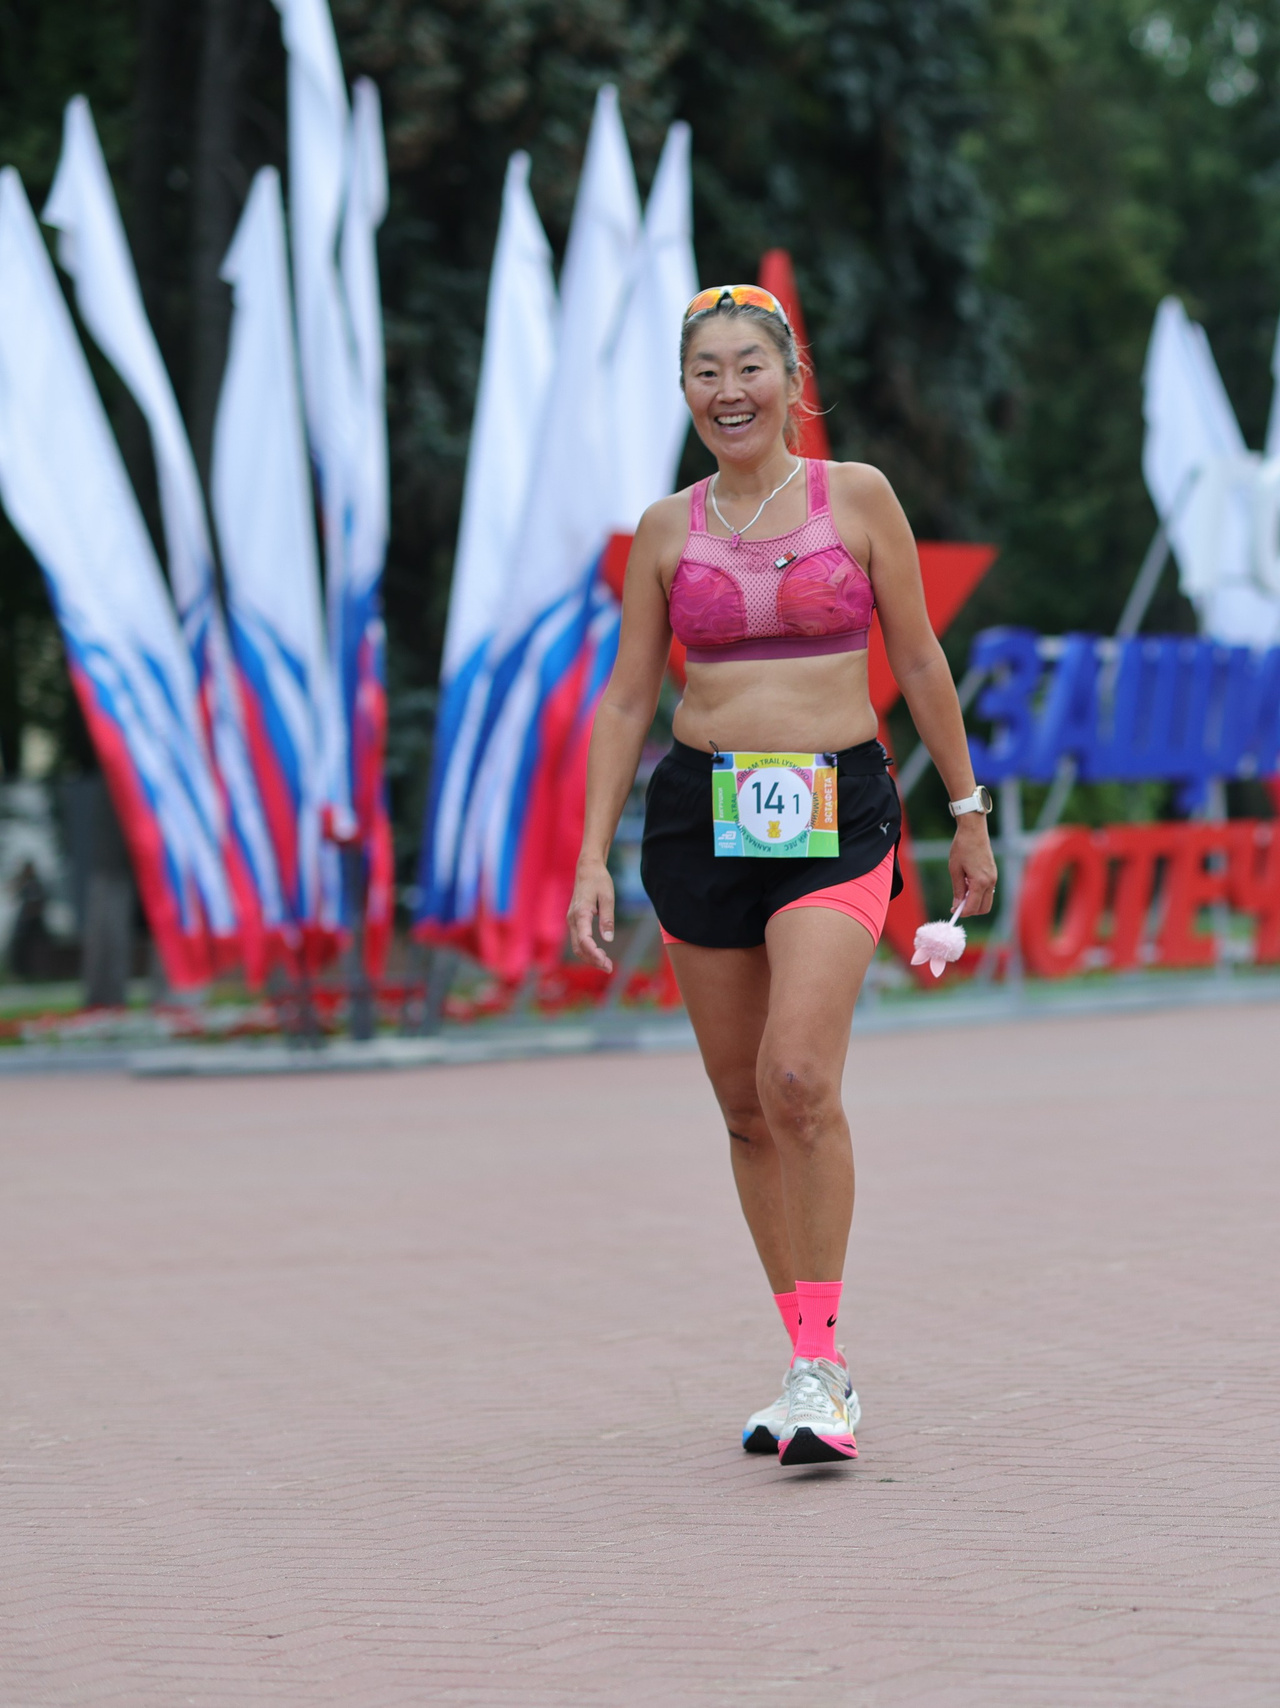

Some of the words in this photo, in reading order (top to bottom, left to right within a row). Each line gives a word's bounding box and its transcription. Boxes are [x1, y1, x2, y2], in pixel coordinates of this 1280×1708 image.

[737, 762, 759, 783] DREAM
[760, 758, 781, 766] TRAIL
[781, 759, 810, 780] LYSKOVO
[752, 782, 785, 814] 14
[793, 794, 800, 814] 1
[824, 777, 833, 823] ЭСТАФЕТА
[745, 834, 771, 852] KANNAS
[784, 841, 798, 851] ЛЕС
